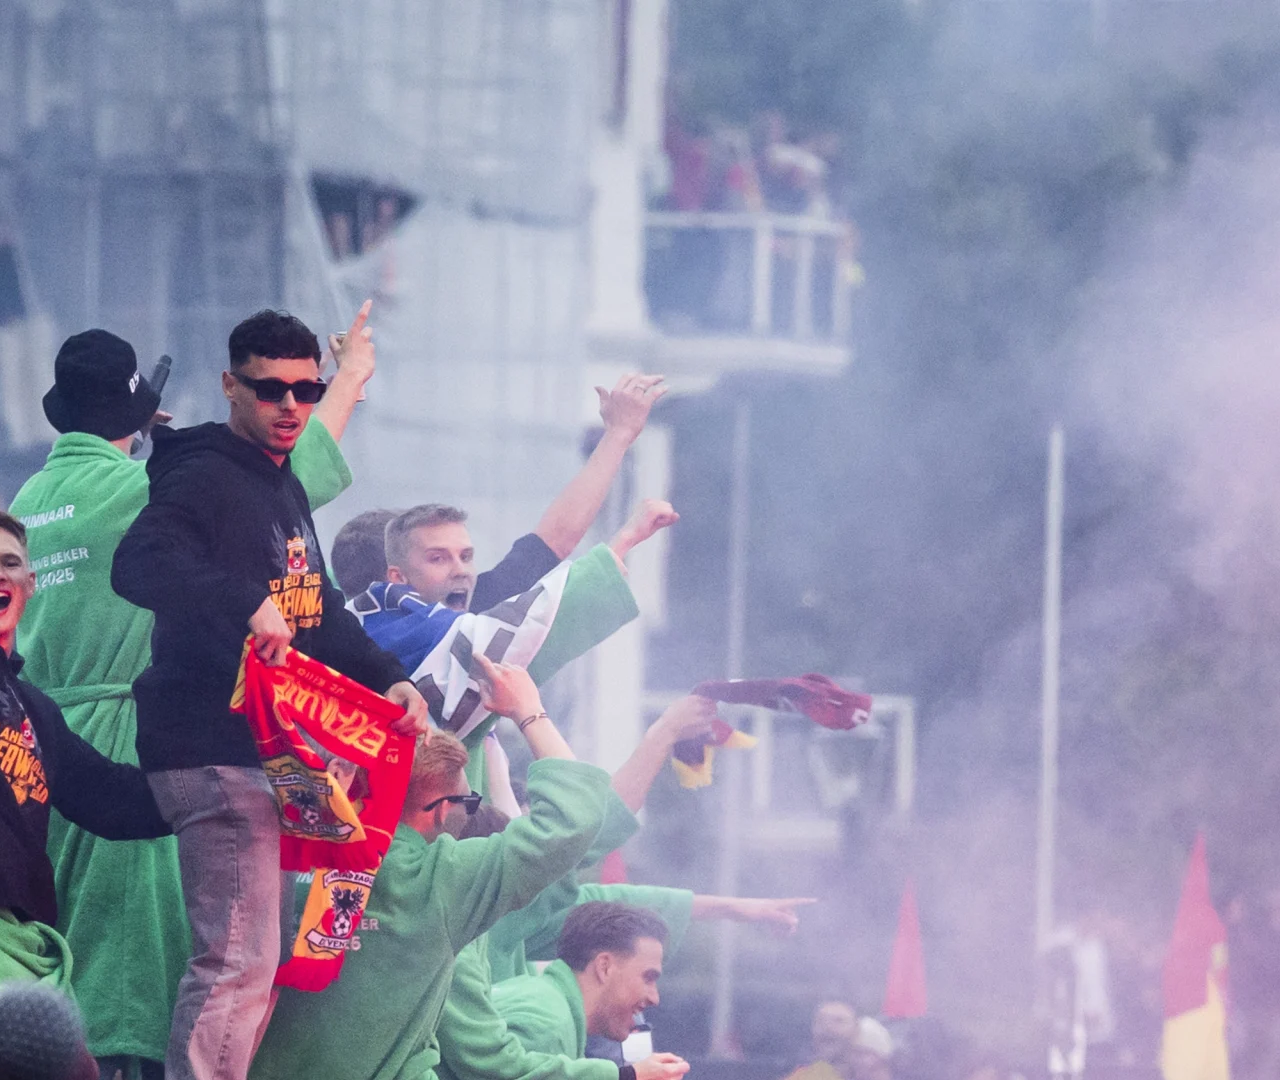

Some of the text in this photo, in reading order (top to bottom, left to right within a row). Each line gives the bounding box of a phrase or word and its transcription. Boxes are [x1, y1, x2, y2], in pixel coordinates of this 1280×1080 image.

[30, 547, 89, 570] NVB BEKER
[0, 727, 25, 746] AHE
